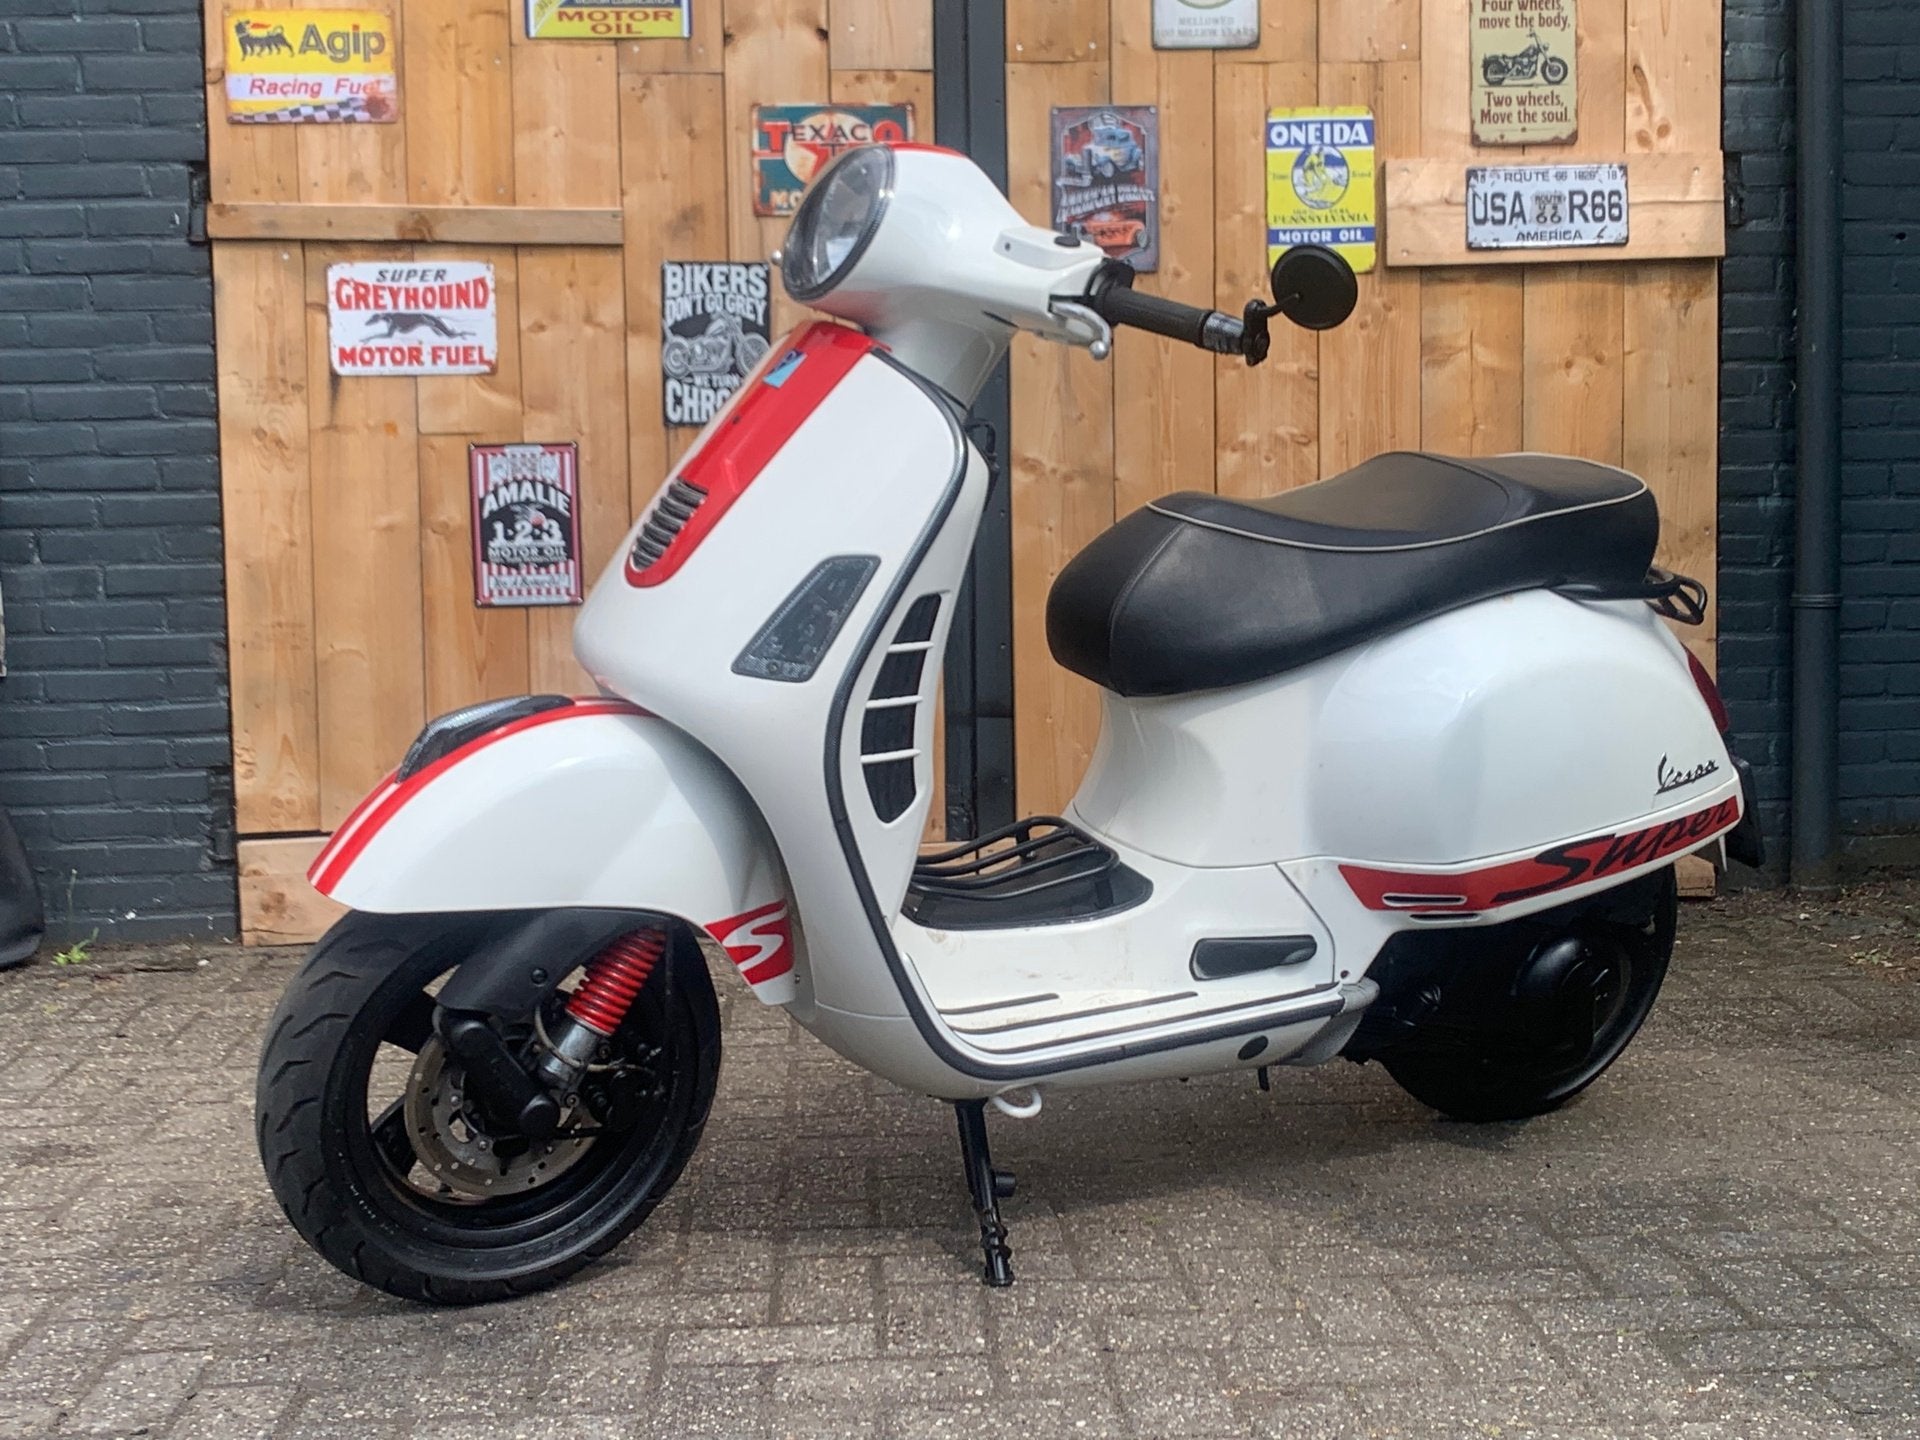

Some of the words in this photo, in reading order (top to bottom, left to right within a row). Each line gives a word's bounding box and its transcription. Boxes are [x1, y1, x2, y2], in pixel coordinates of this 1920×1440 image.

[557, 10, 674, 22] MOTOR
[1479, 17, 1511, 29] move
[1515, 12, 1535, 28] the
[590, 23, 643, 34] OIL
[298, 23, 386, 63] Agip
[250, 78, 323, 99] Racing
[1484, 91, 1513, 107] Two
[1480, 109, 1513, 124] Move
[1517, 108, 1538, 123] the
[760, 120, 905, 152] TEXACO
[1270, 122, 1369, 146] ONEIDA
[1503, 171, 1550, 183] ROUTE
[1273, 212, 1370, 225] PENNSYLVANIA
[1472, 191, 1528, 226] USA
[1568, 190, 1623, 224] R66
[1278, 230, 1333, 243] MOTOR
[1339, 229, 1366, 242] OIL
[1515, 230, 1583, 242] AMERICA
[376, 269, 448, 283] SUPER
[666, 263, 769, 299] BIKERS
[335, 276, 490, 311] GREYHOUND
[704, 294, 725, 314] GO
[725, 296, 768, 326] GREY
[338, 346, 425, 367] MOTOR
[431, 346, 494, 368] FUEL
[665, 378, 732, 424] CHRO
[483, 480, 571, 519] AMALIE
[1655, 752, 1720, 796] Vespa
